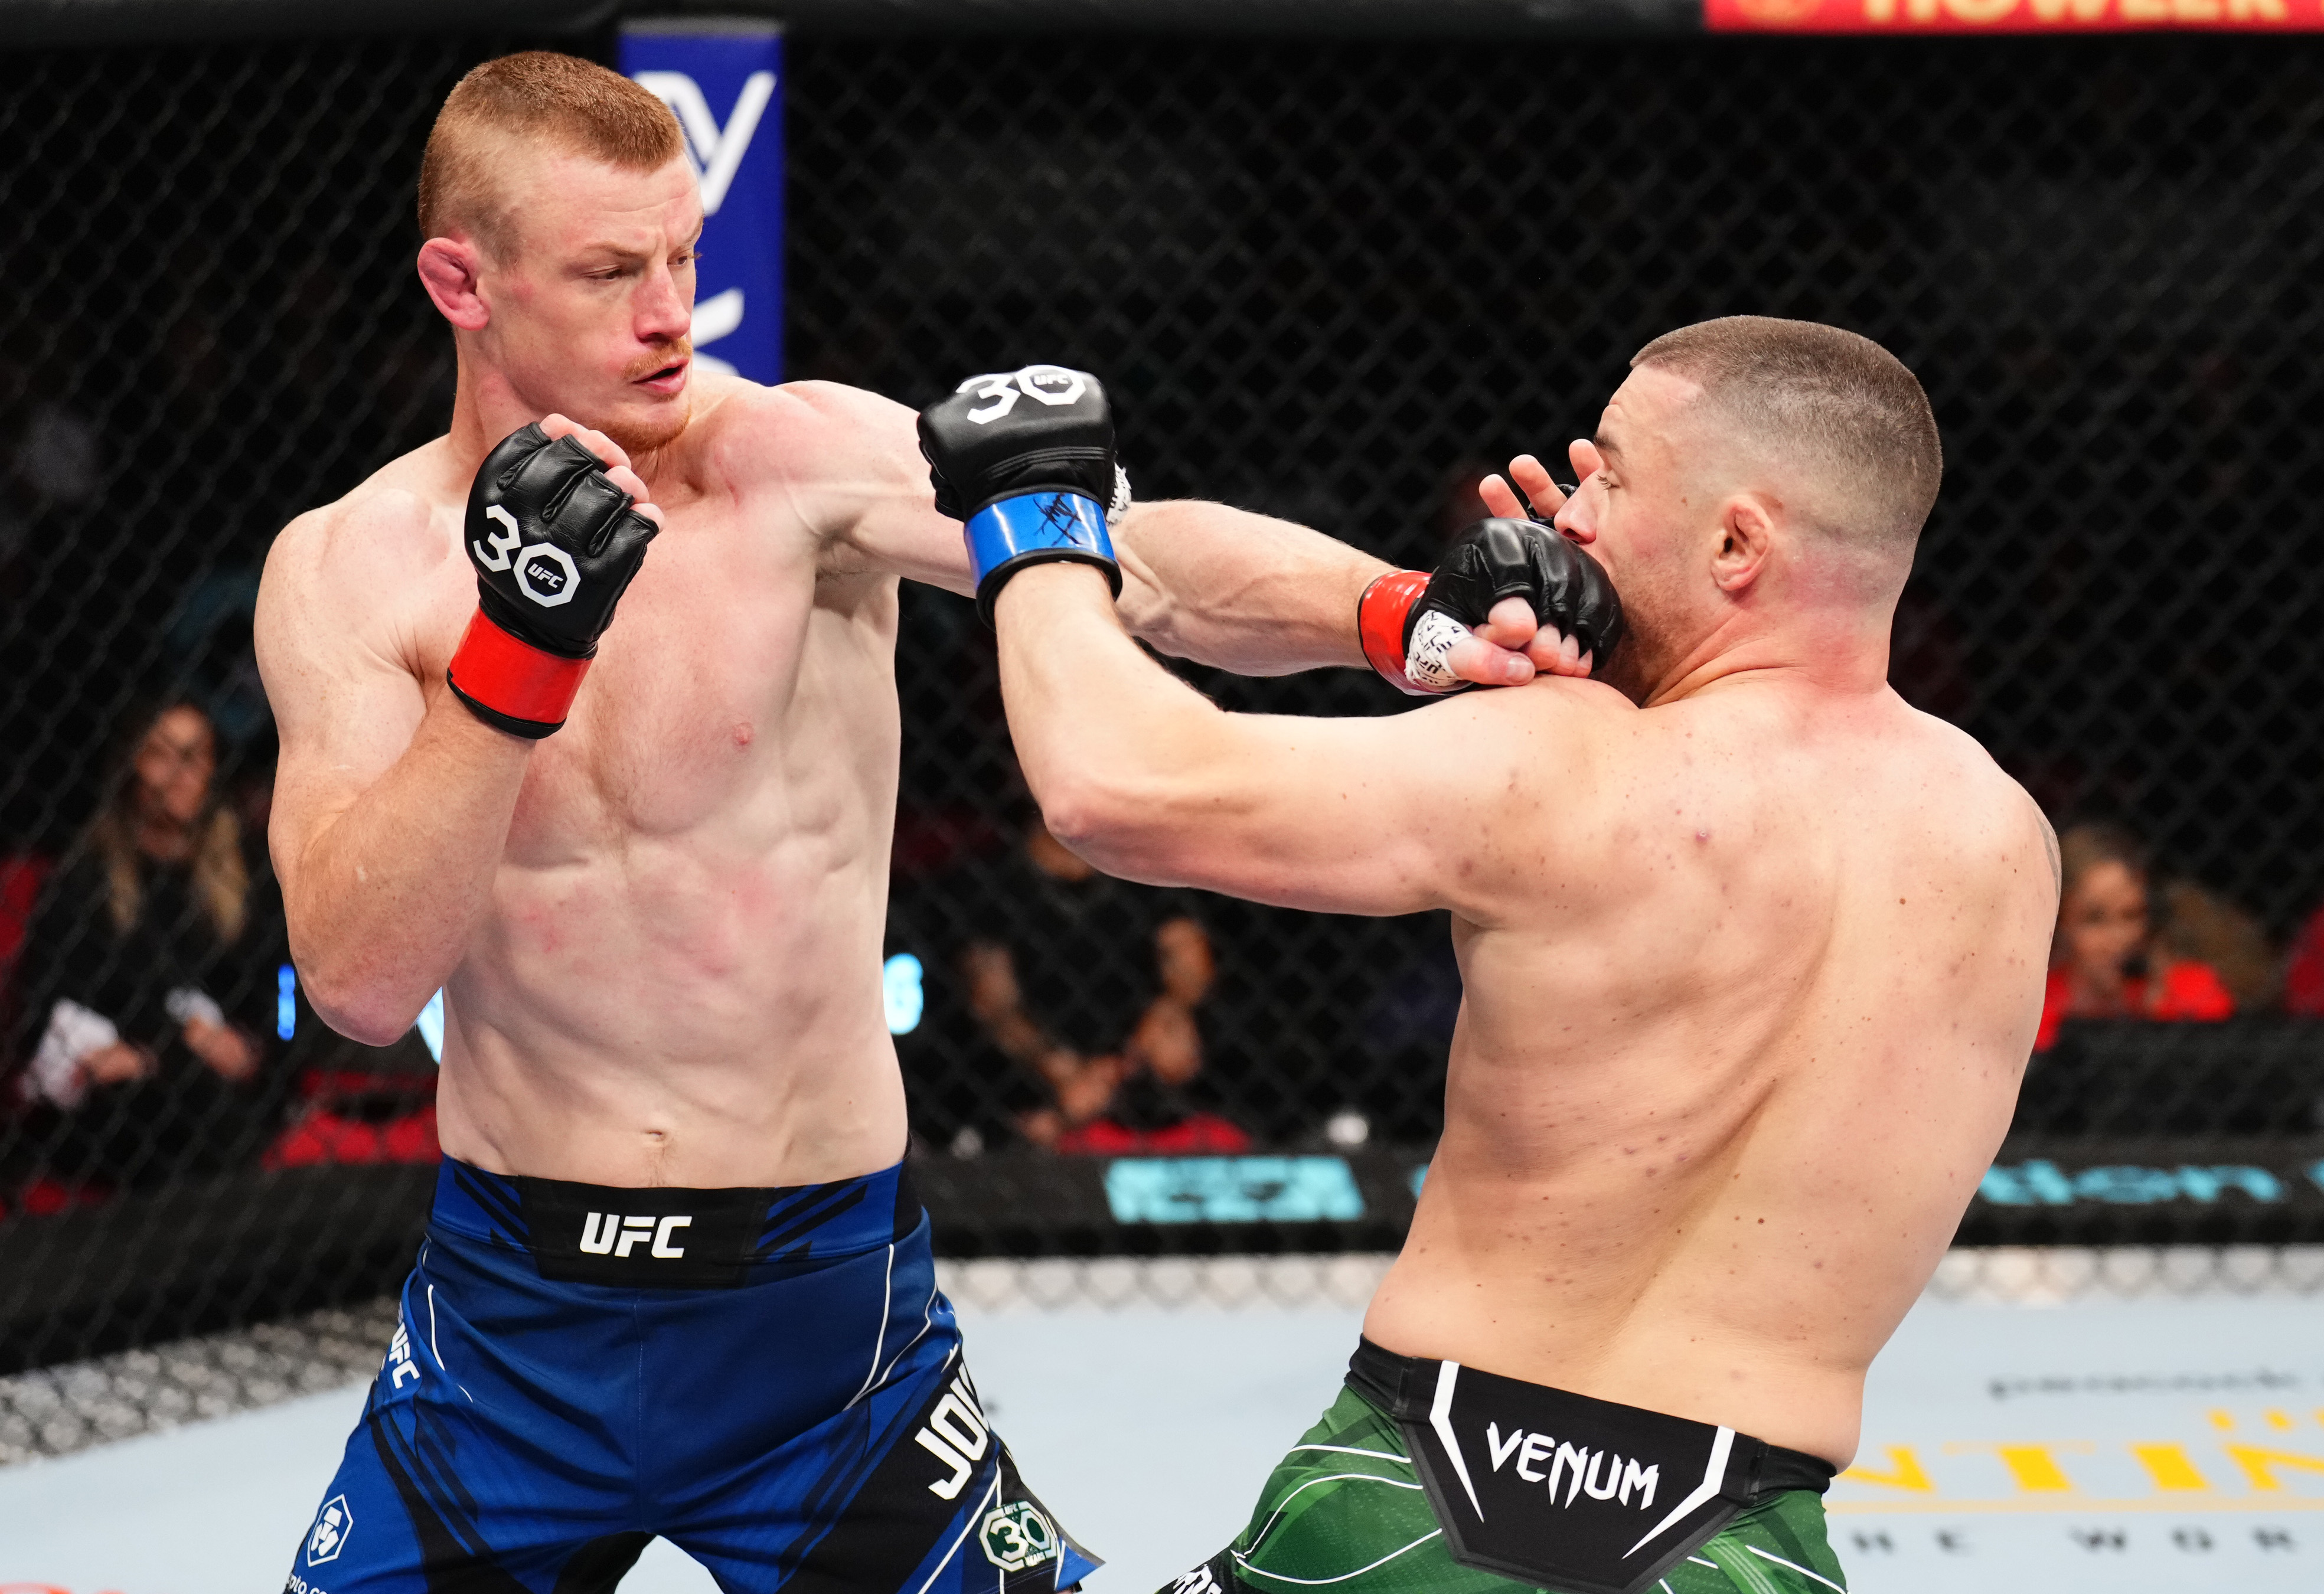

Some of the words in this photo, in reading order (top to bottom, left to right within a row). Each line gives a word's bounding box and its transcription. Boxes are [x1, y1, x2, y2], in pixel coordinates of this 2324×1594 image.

[955, 364, 1086, 424] 30
[1034, 374, 1069, 386] UFC
[473, 504, 581, 608] 30
[528, 563, 564, 589] UFC
[579, 1211, 693, 1259] UFC
[389, 1321, 420, 1390] UFC
[1486, 1420, 1660, 1511] VENUM
